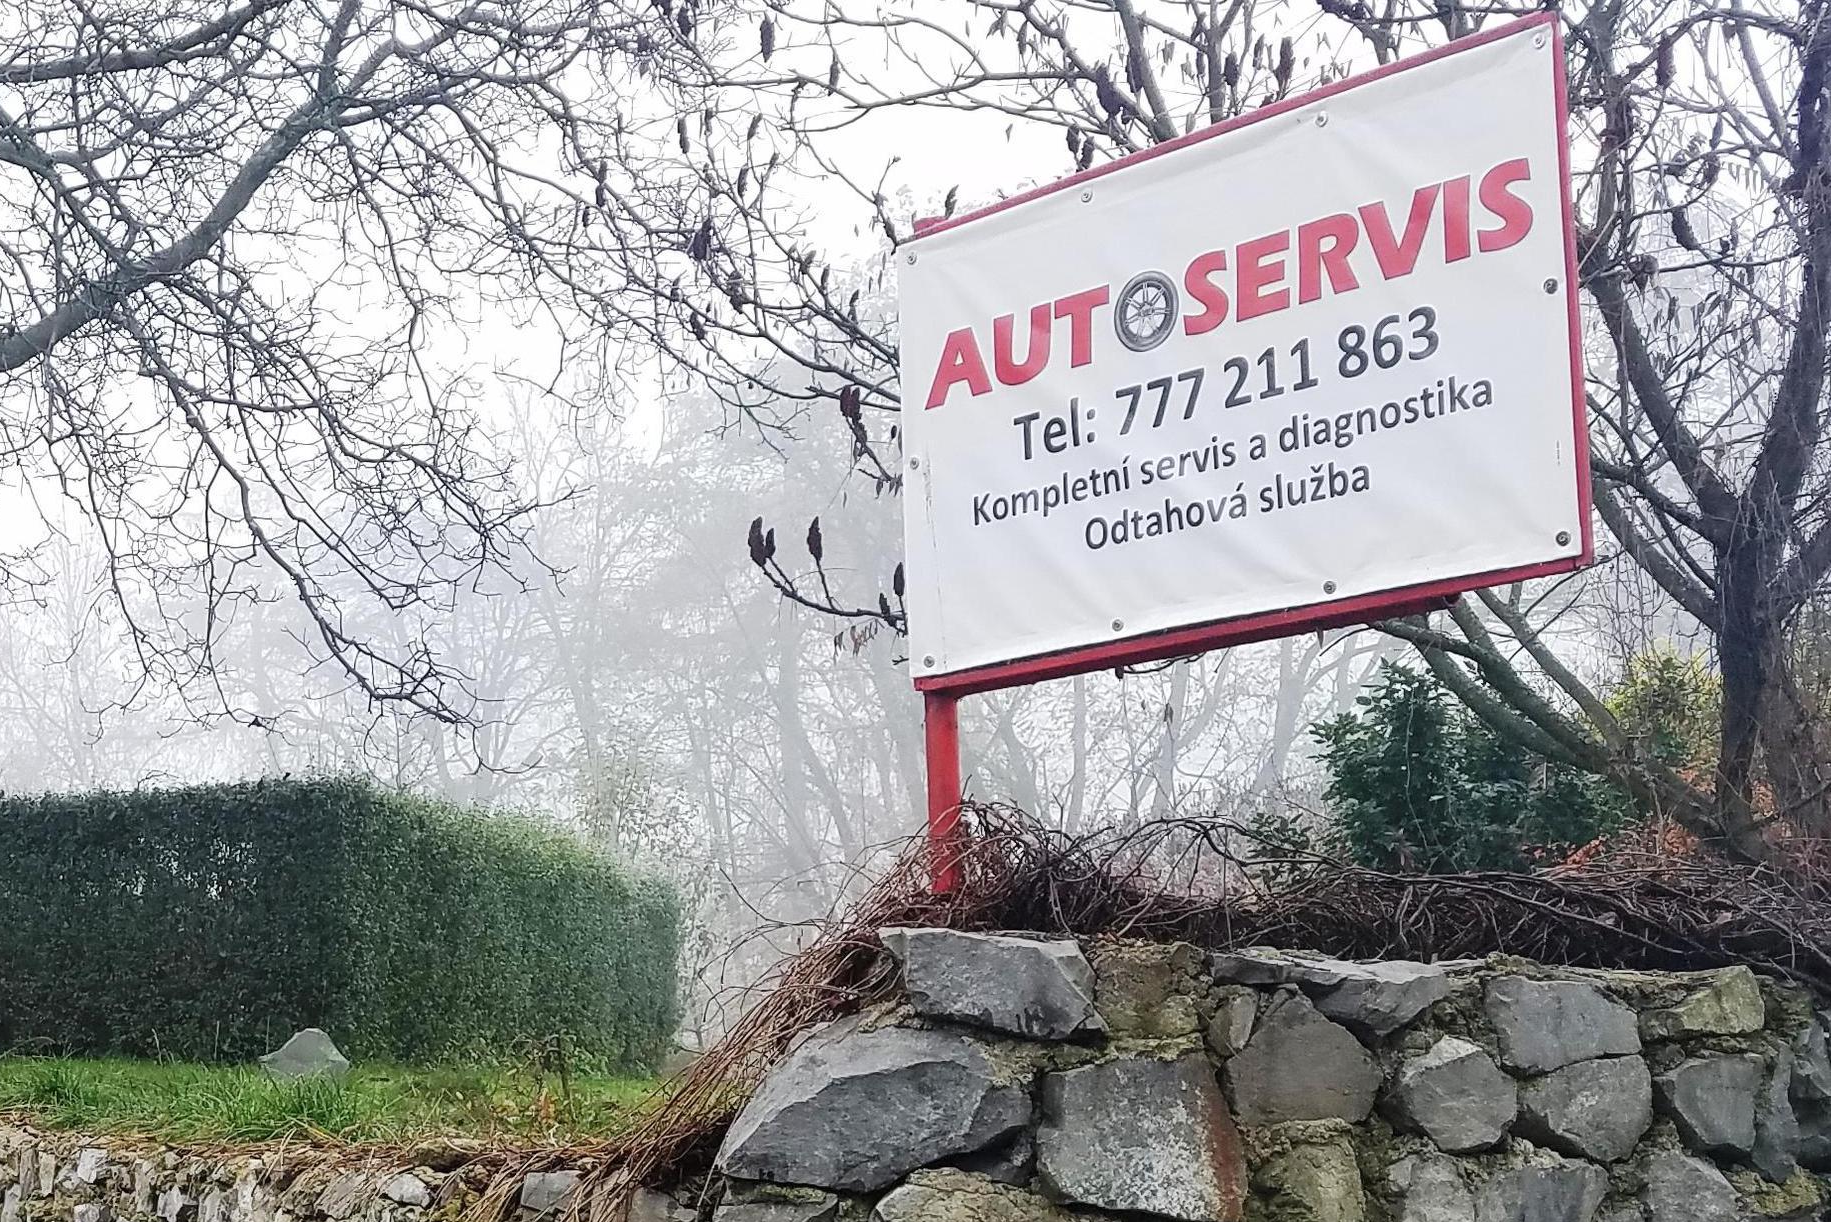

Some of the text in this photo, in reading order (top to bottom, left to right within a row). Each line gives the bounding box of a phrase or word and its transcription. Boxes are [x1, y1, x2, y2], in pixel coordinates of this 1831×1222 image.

[973, 455, 1131, 526] Kompletní
[1140, 436, 1237, 485] servis
[1249, 432, 1267, 461] a
[1279, 375, 1493, 453] diagnostika
[1013, 306, 1439, 460] Tel: 777 211 863
[1085, 461, 1371, 550] Odtahová služba
